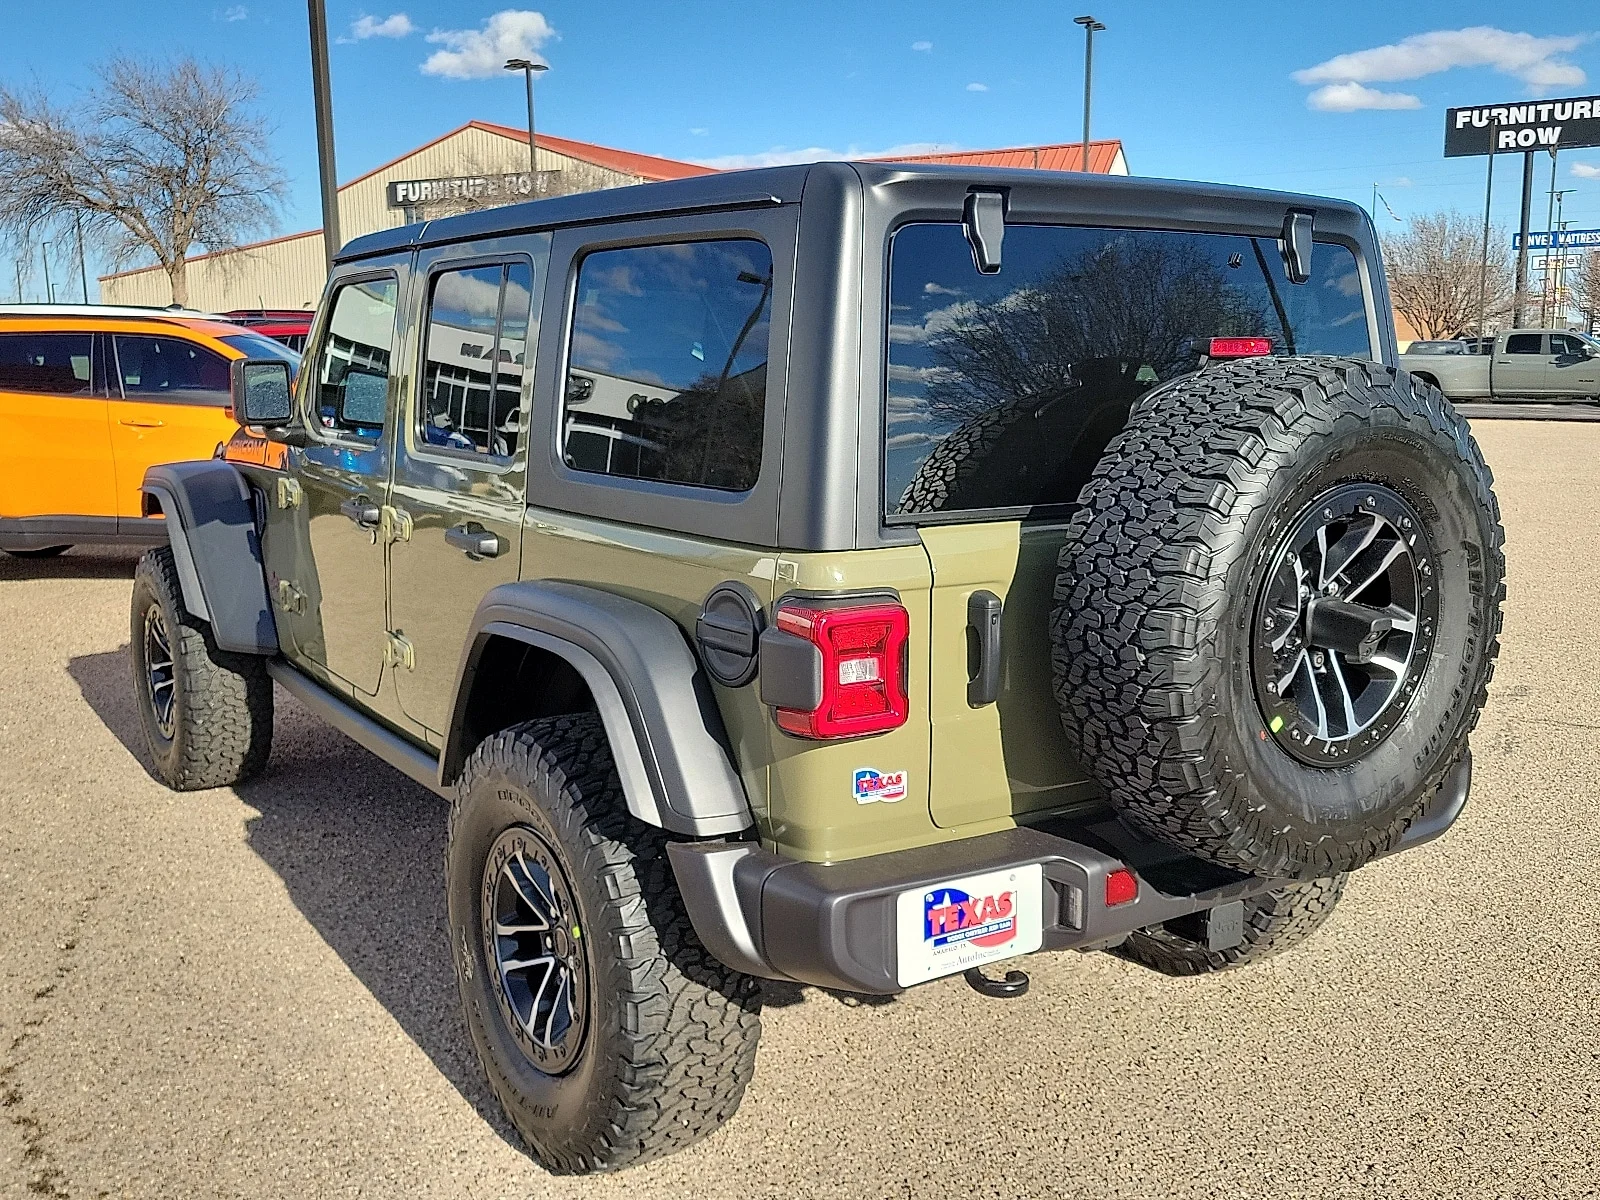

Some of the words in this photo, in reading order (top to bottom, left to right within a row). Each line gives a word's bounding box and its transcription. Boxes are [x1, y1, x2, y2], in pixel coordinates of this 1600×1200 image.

[1498, 126, 1562, 149] ROW
[396, 176, 499, 202] FURNITURE
[504, 173, 549, 195] ROW
[1515, 234, 1554, 246] DNVER
[857, 773, 903, 793] TEXAS
[927, 890, 1013, 936] TEXAS
